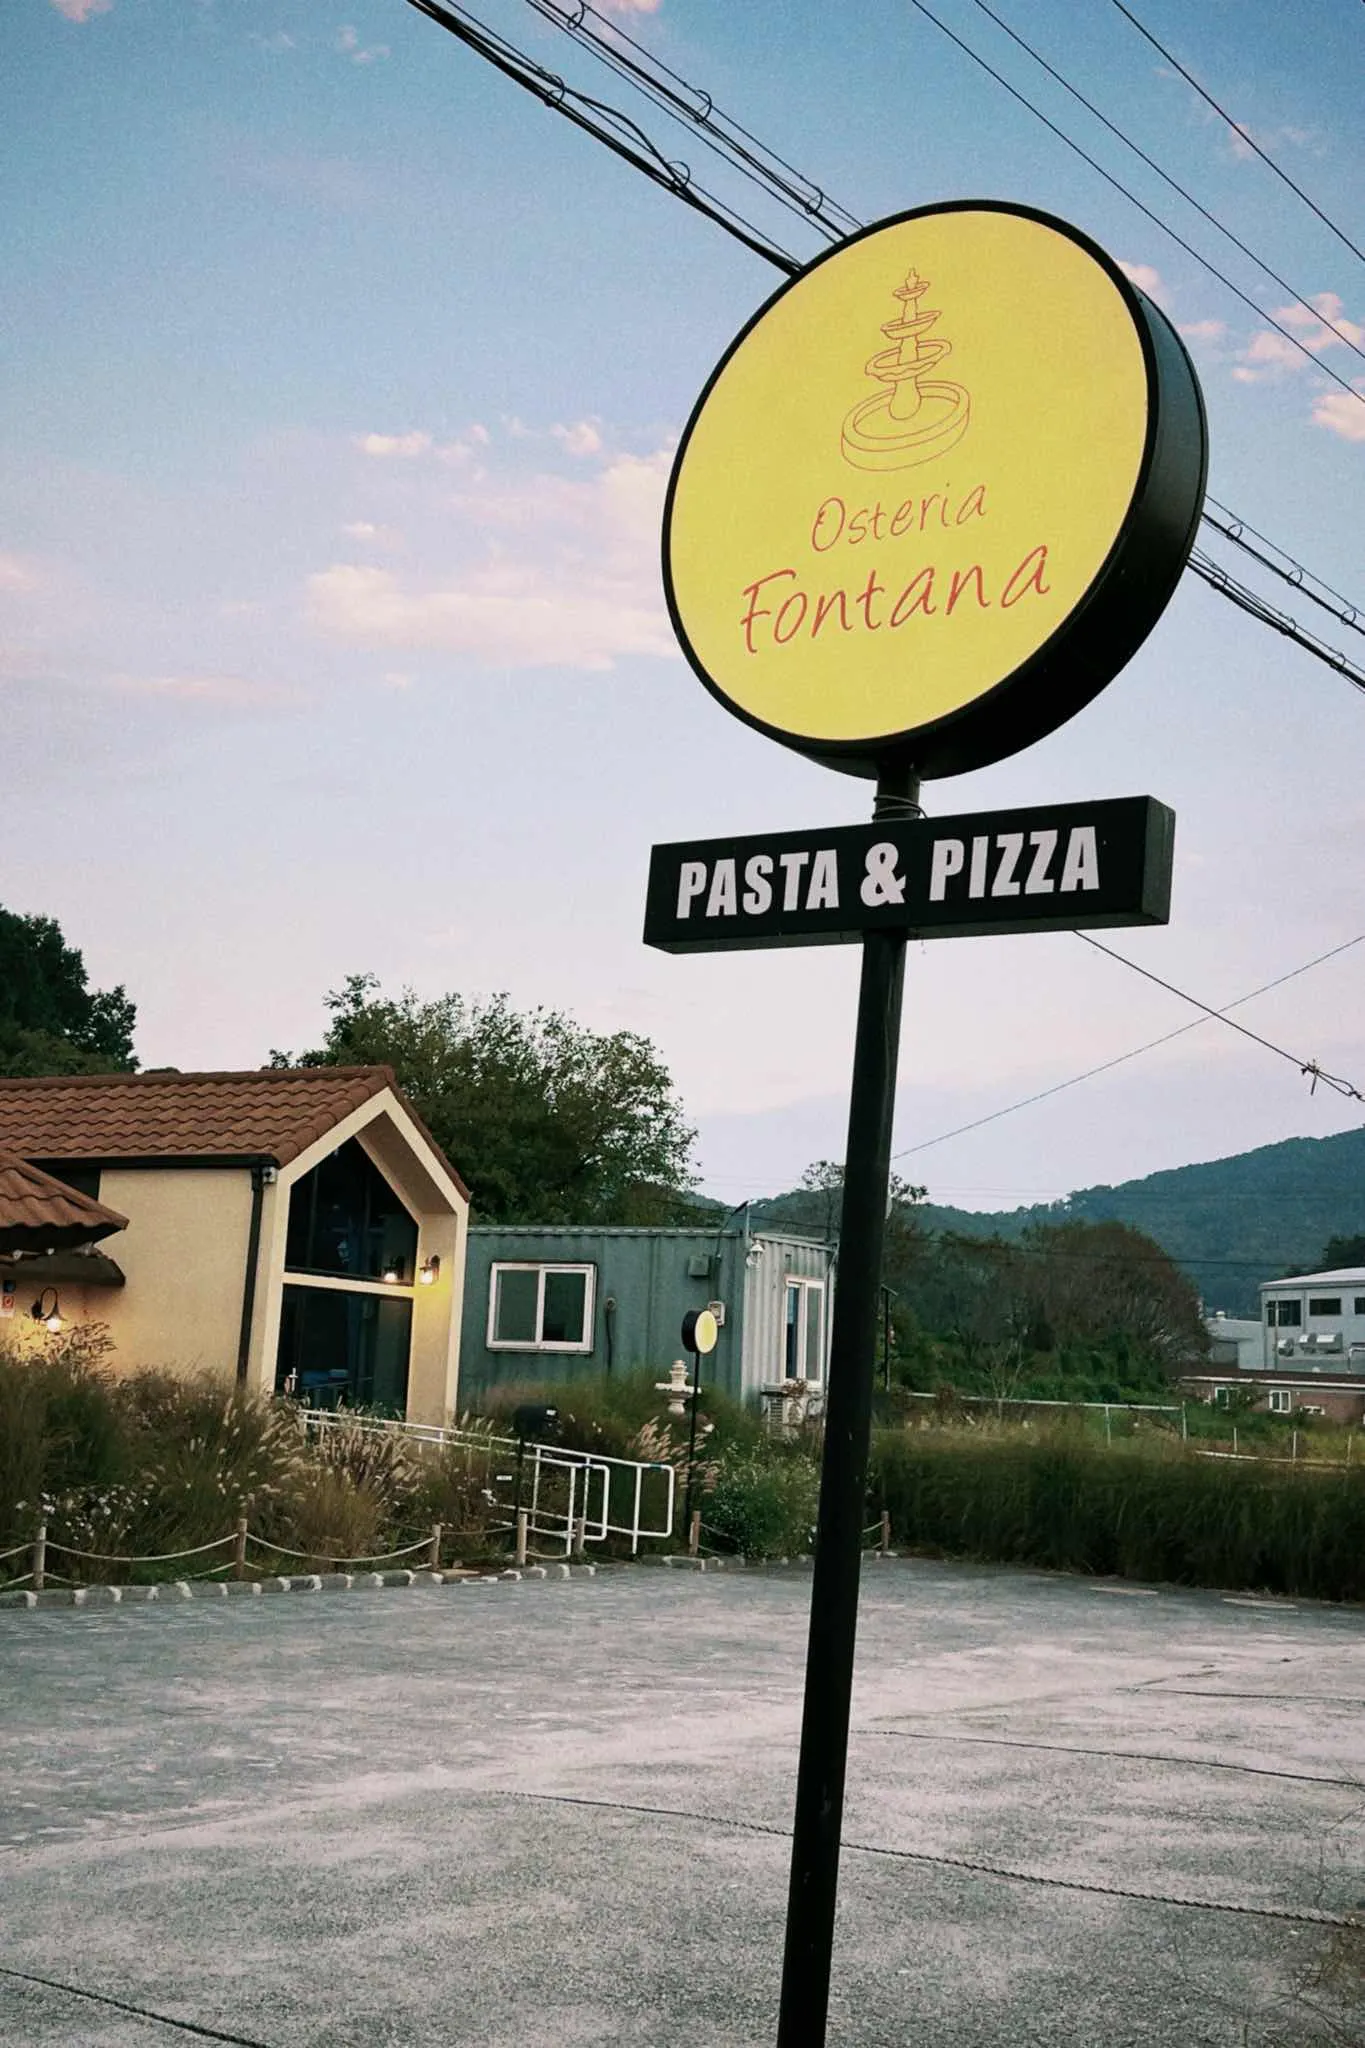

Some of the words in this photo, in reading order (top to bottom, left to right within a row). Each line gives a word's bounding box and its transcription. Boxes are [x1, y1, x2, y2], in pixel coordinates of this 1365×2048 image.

[811, 483, 986, 552] Osteria
[740, 544, 1050, 654] Fontana
[676, 850, 840, 919] PASTA
[860, 842, 906, 907] &
[929, 826, 1100, 901] PIZZA
